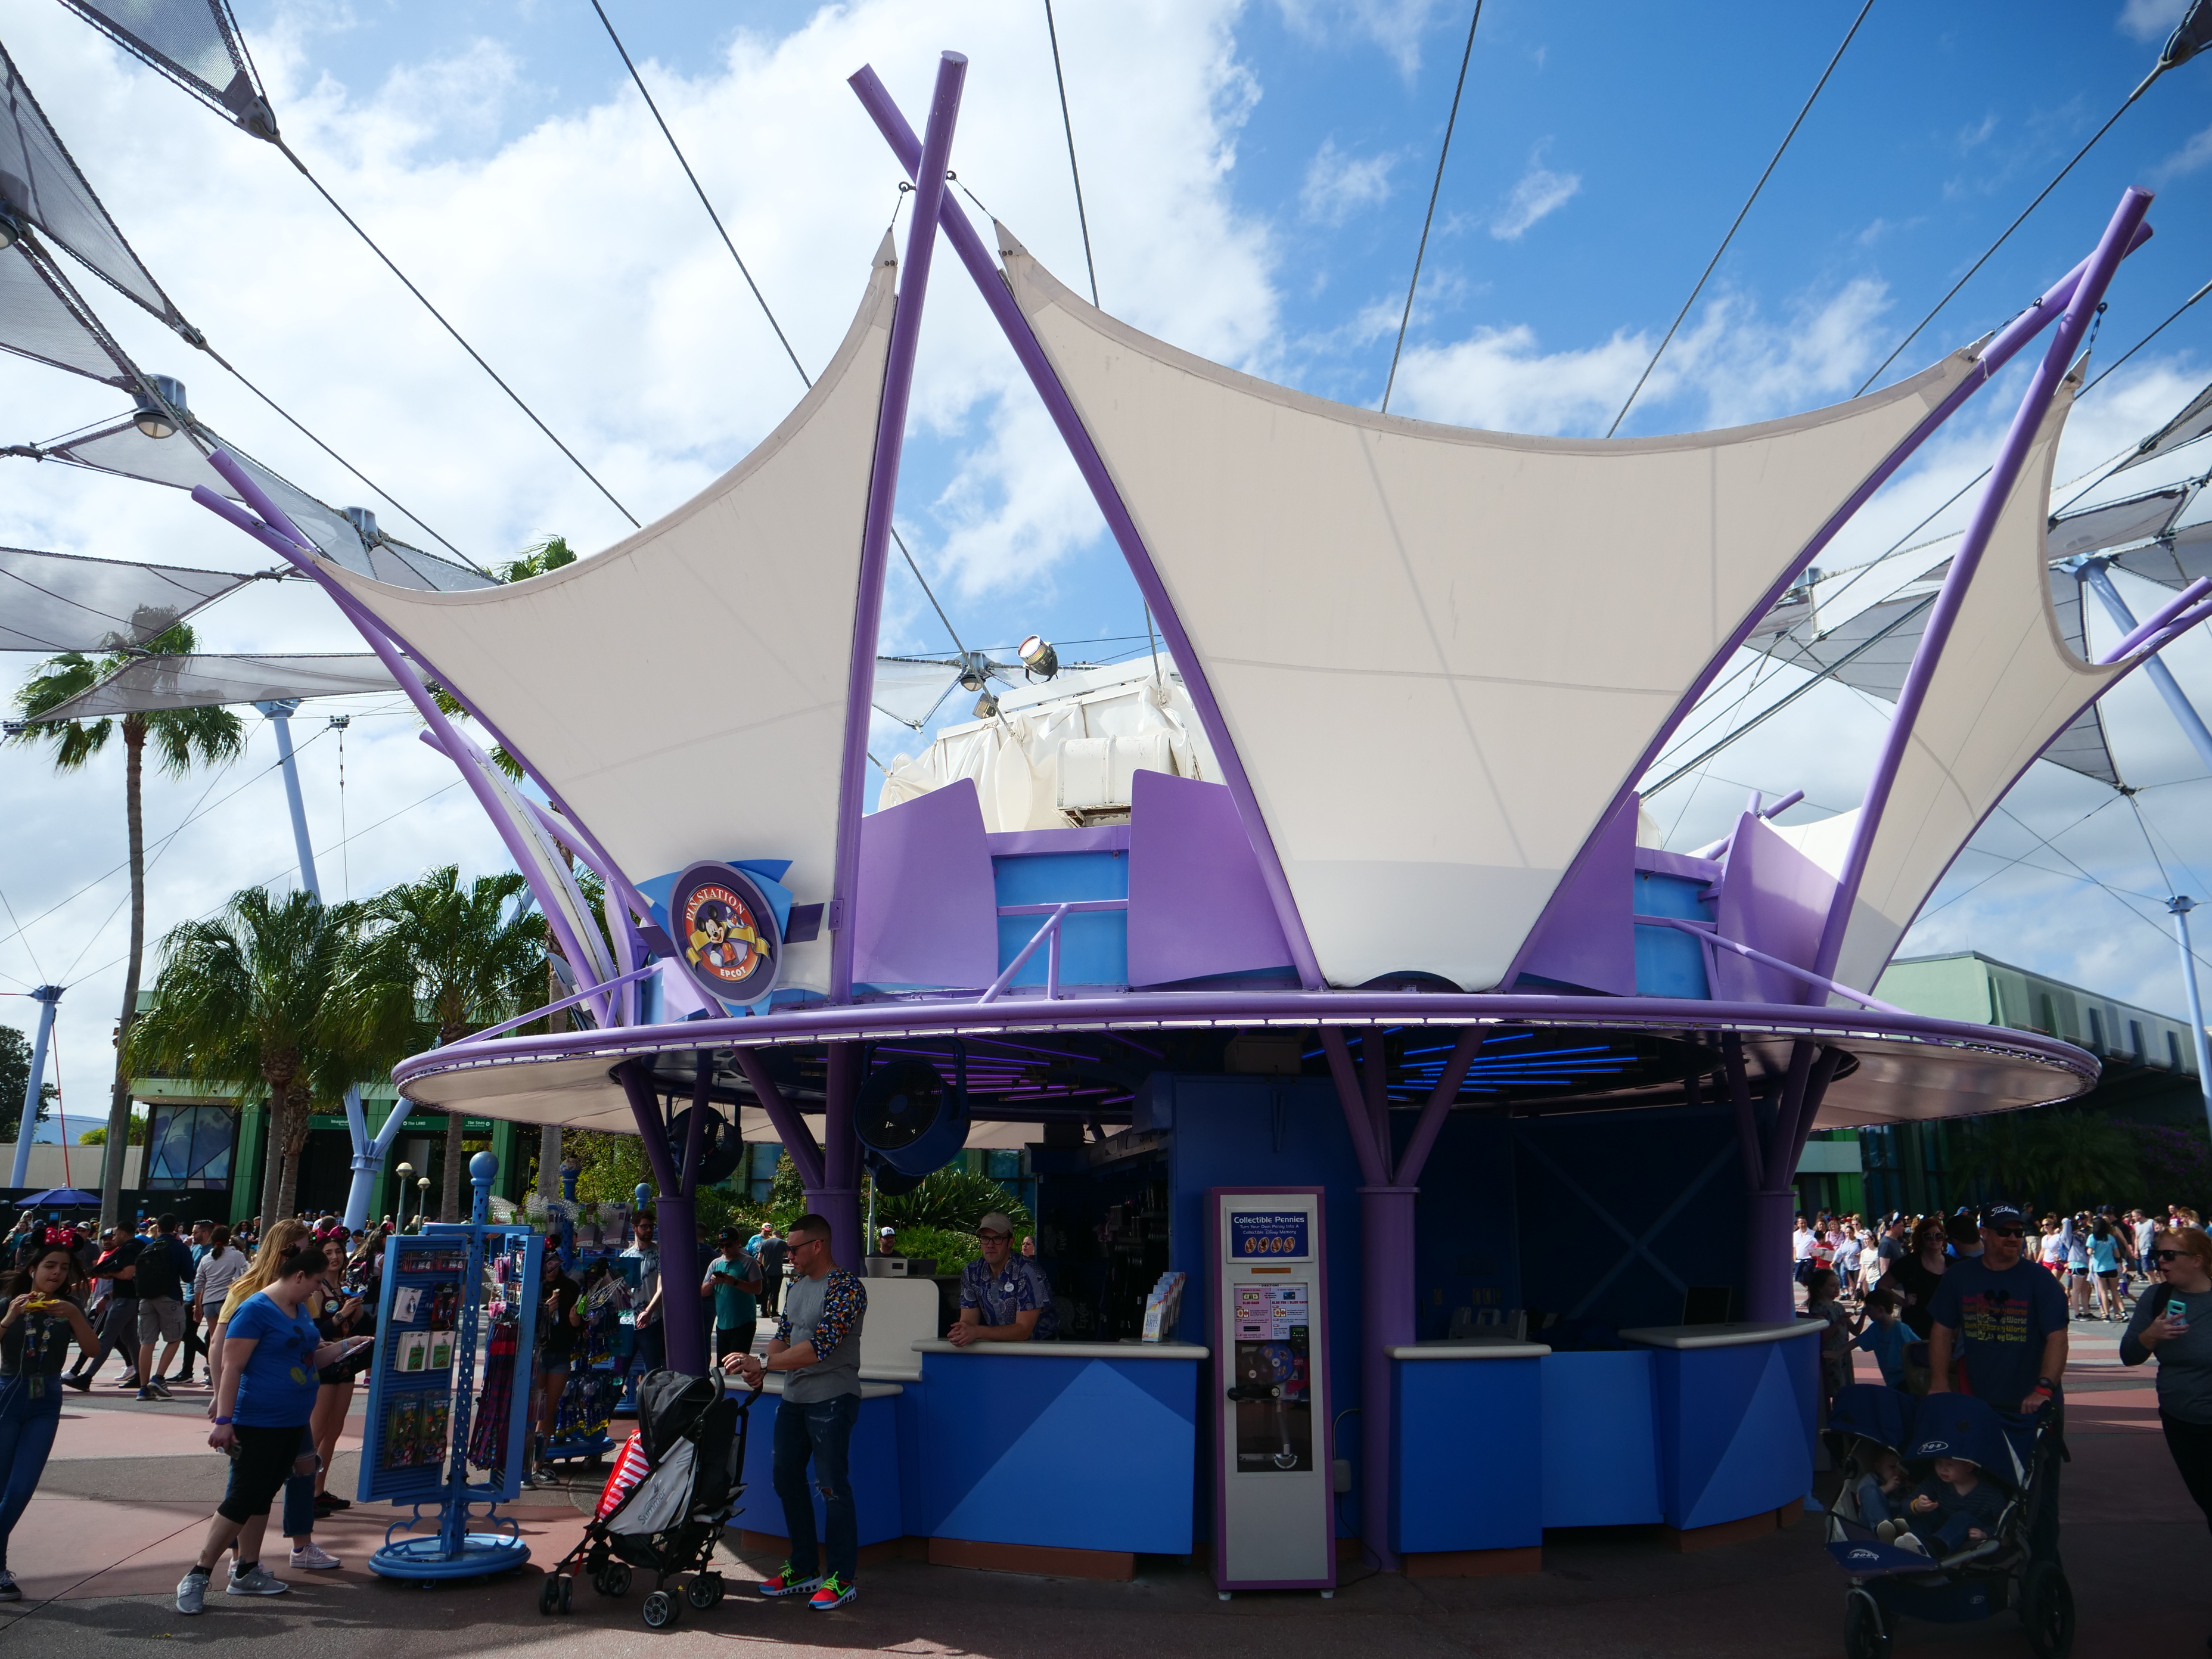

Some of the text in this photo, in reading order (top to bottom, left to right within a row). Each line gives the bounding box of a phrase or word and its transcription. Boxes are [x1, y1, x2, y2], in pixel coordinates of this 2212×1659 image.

[686, 888, 745, 922] PIN STATION
[720, 966, 747, 978] EPCOT
[1147, 1319, 1159, 1327] ARTS
[2006, 1316, 2027, 1325] World
[2006, 1325, 2027, 1334] World
[2006, 1334, 2027, 1342] World
[638, 1488, 666, 1525] Summer
